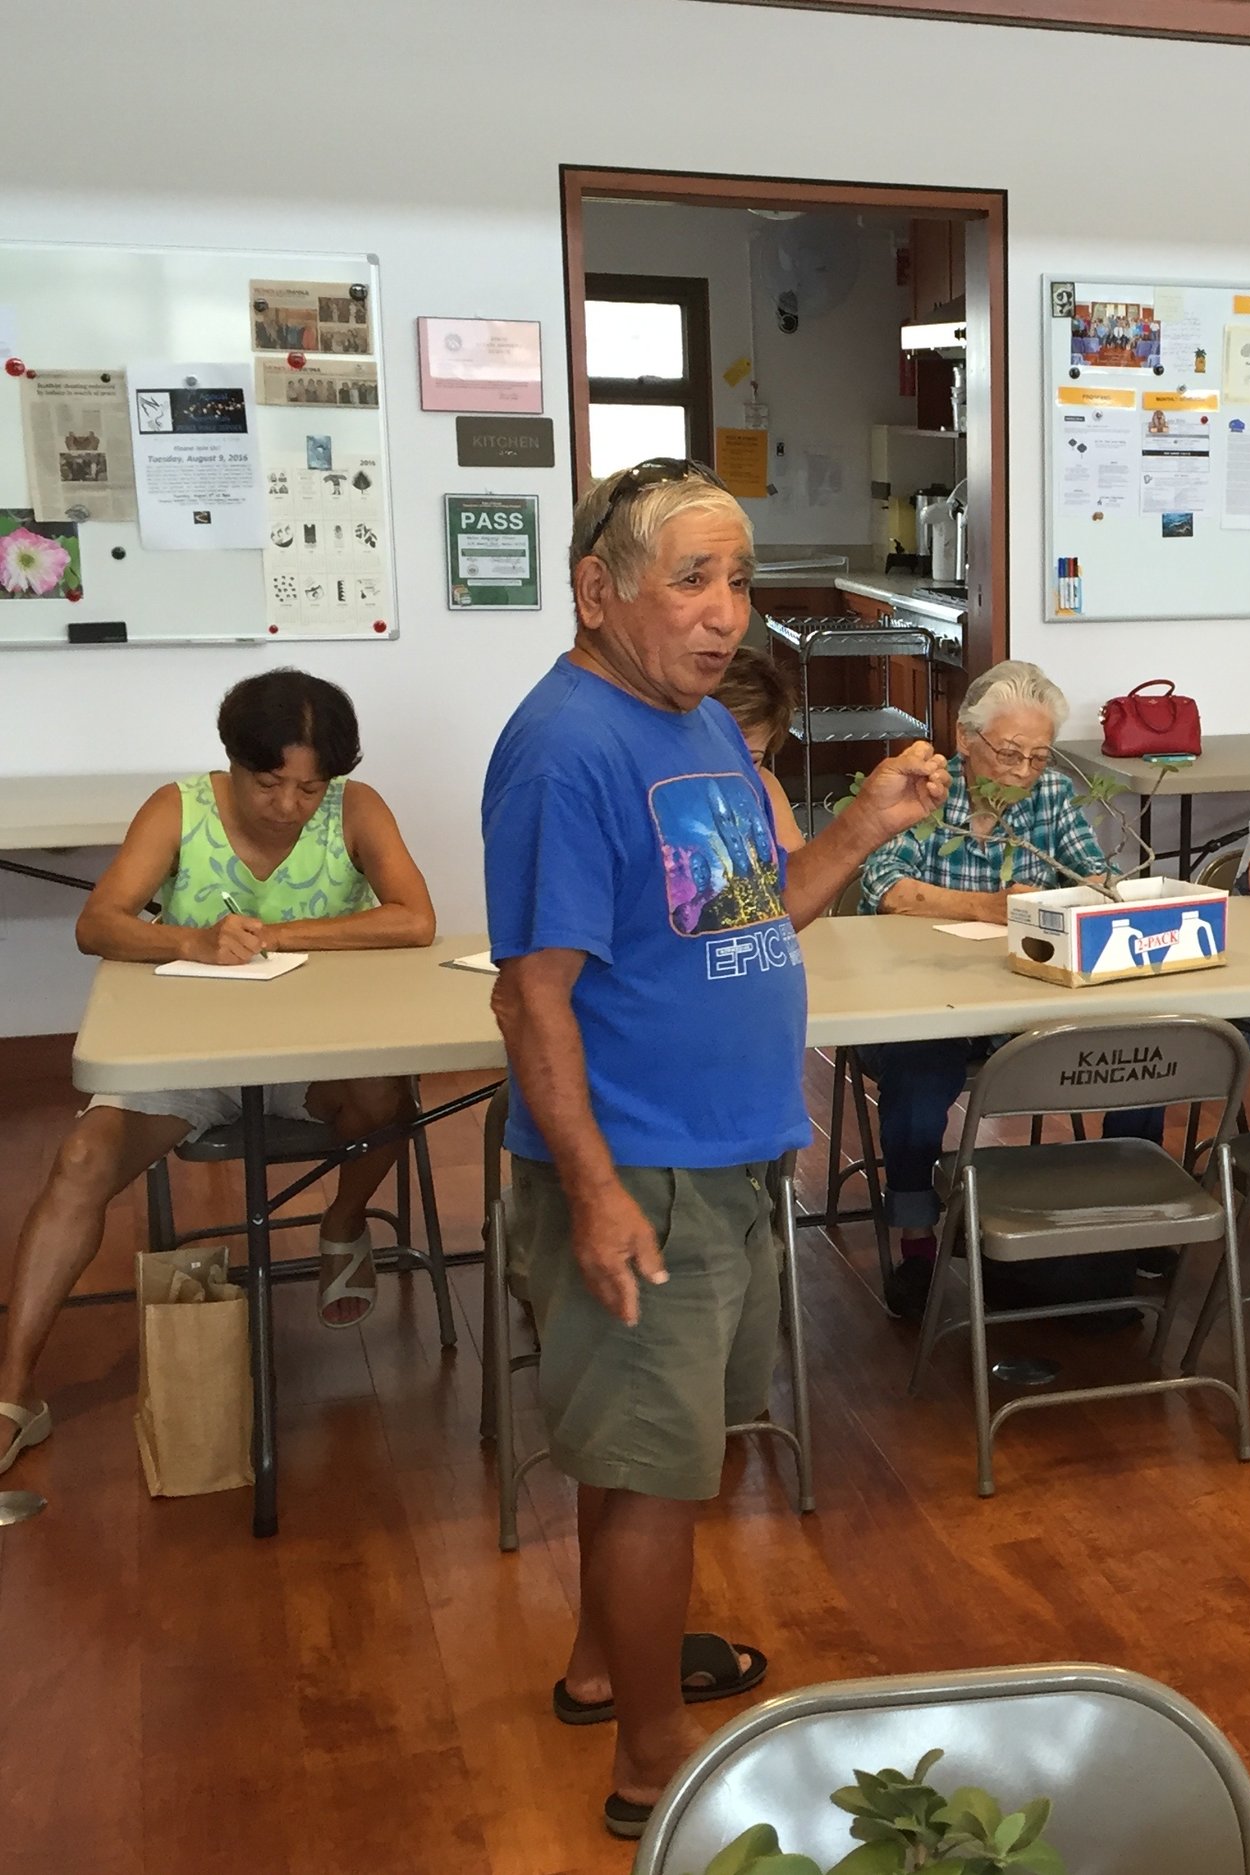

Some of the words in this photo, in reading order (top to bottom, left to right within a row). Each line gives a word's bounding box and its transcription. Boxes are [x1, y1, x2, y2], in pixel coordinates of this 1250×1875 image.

[472, 435, 540, 449] KITCHEN
[148, 455, 184, 464] Tuesday,
[187, 454, 216, 464] August
[228, 453, 249, 462] 2016
[461, 512, 524, 530] PASS
[1137, 931, 1179, 951] 2-PACK
[706, 927, 787, 980] EPIC
[1078, 1045, 1164, 1068] KAILUA
[1060, 1061, 1178, 1086] HONGANJI
